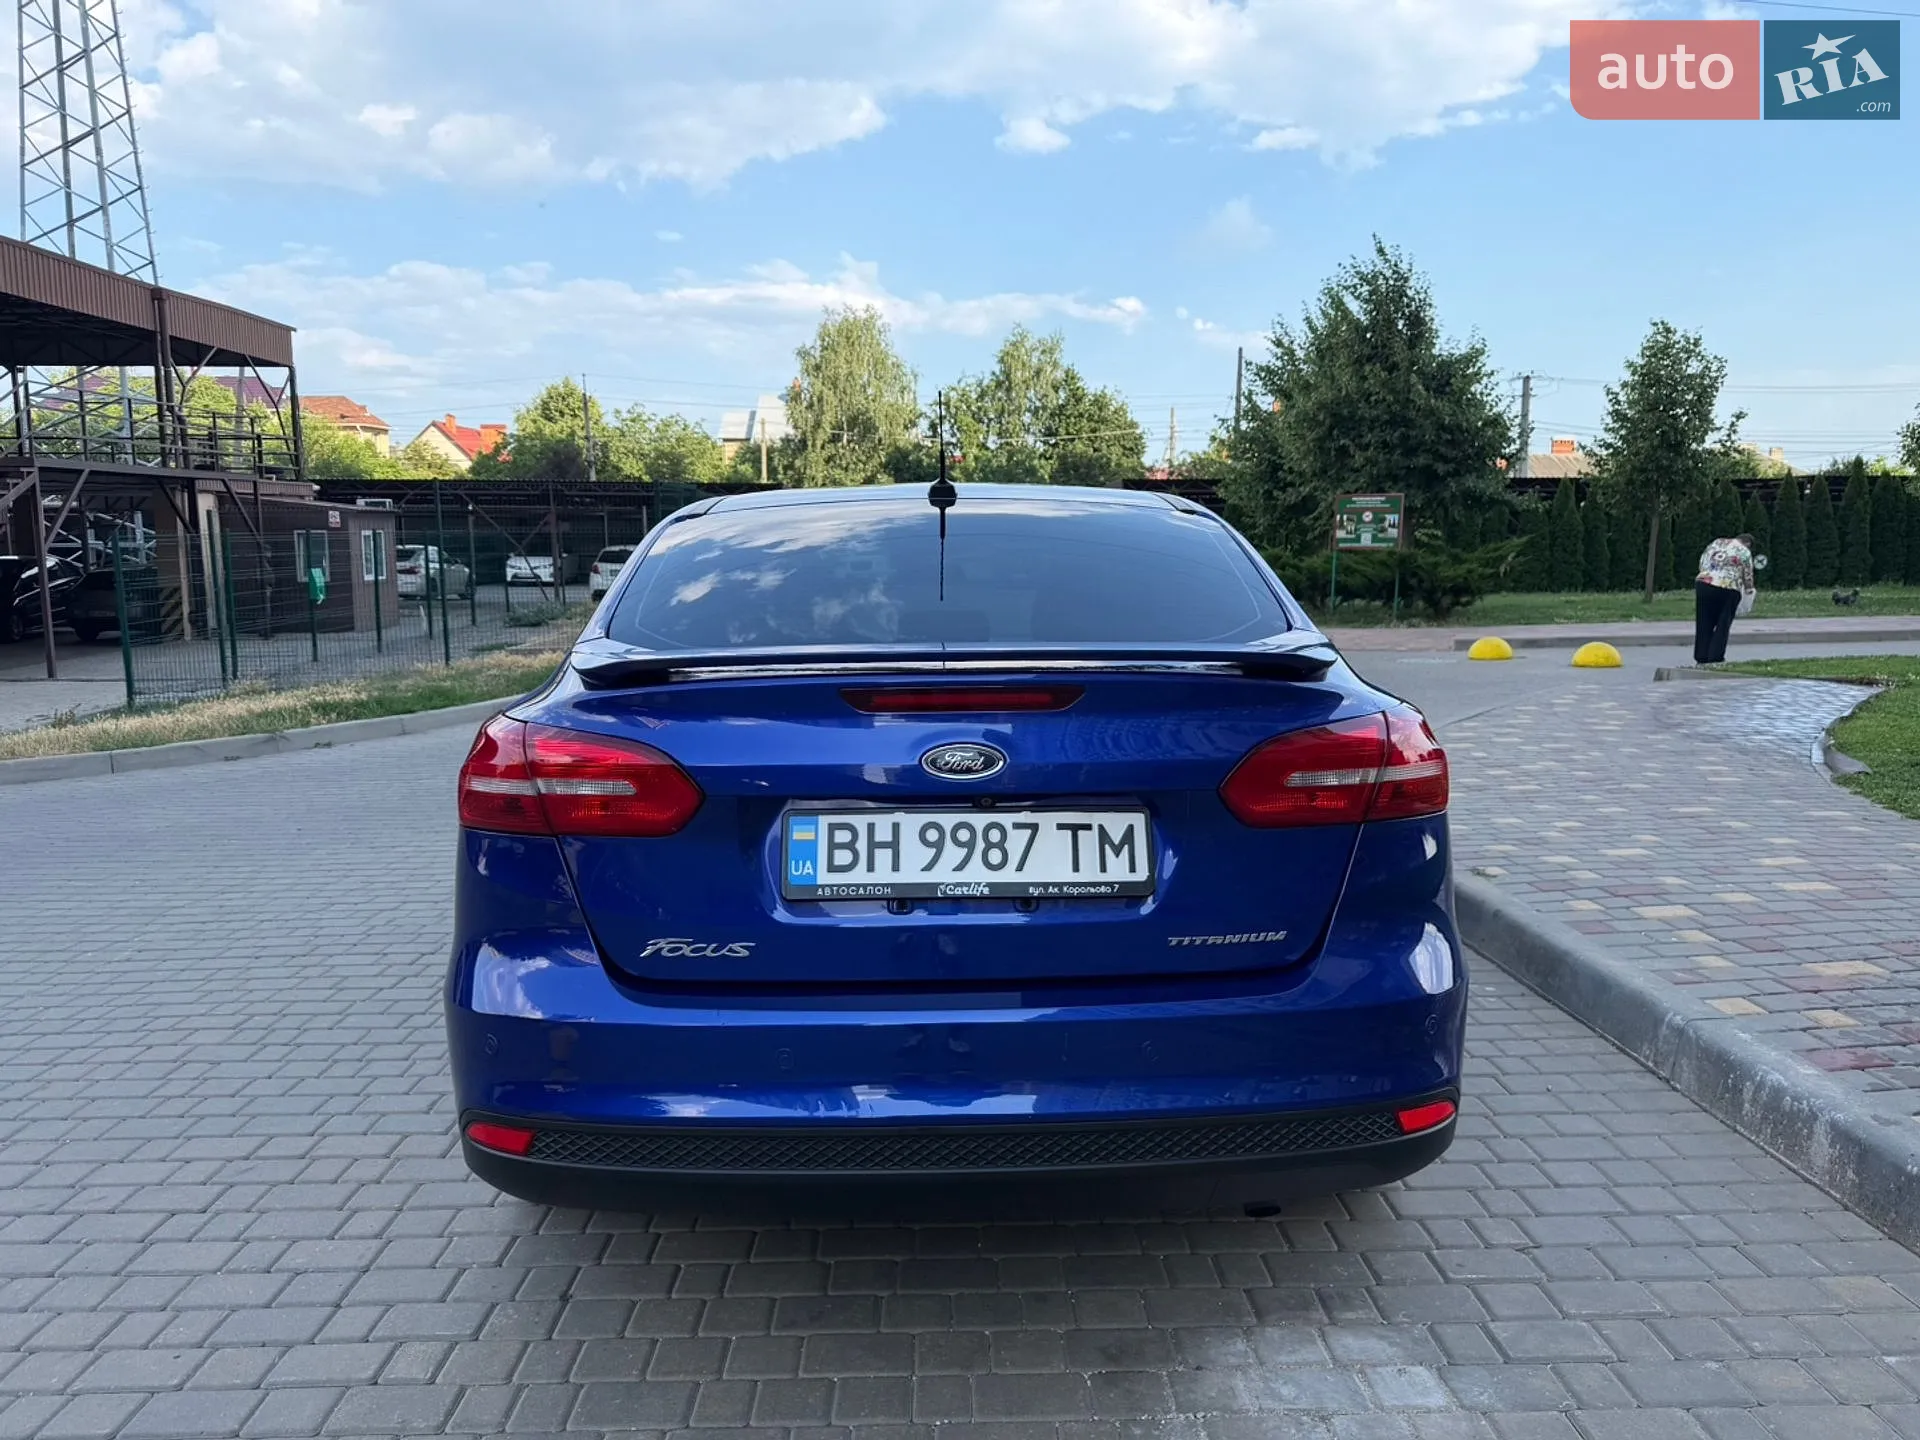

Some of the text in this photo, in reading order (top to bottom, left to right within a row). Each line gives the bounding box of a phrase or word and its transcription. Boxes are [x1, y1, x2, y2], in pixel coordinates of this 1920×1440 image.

[938, 751, 985, 771] Ford
[826, 821, 1137, 874] BH 9987 TM
[791, 860, 814, 876] UA
[817, 886, 892, 896] АВТОСАЛОН
[1113, 884, 1120, 894] 7
[1168, 930, 1288, 946] TITANIUM
